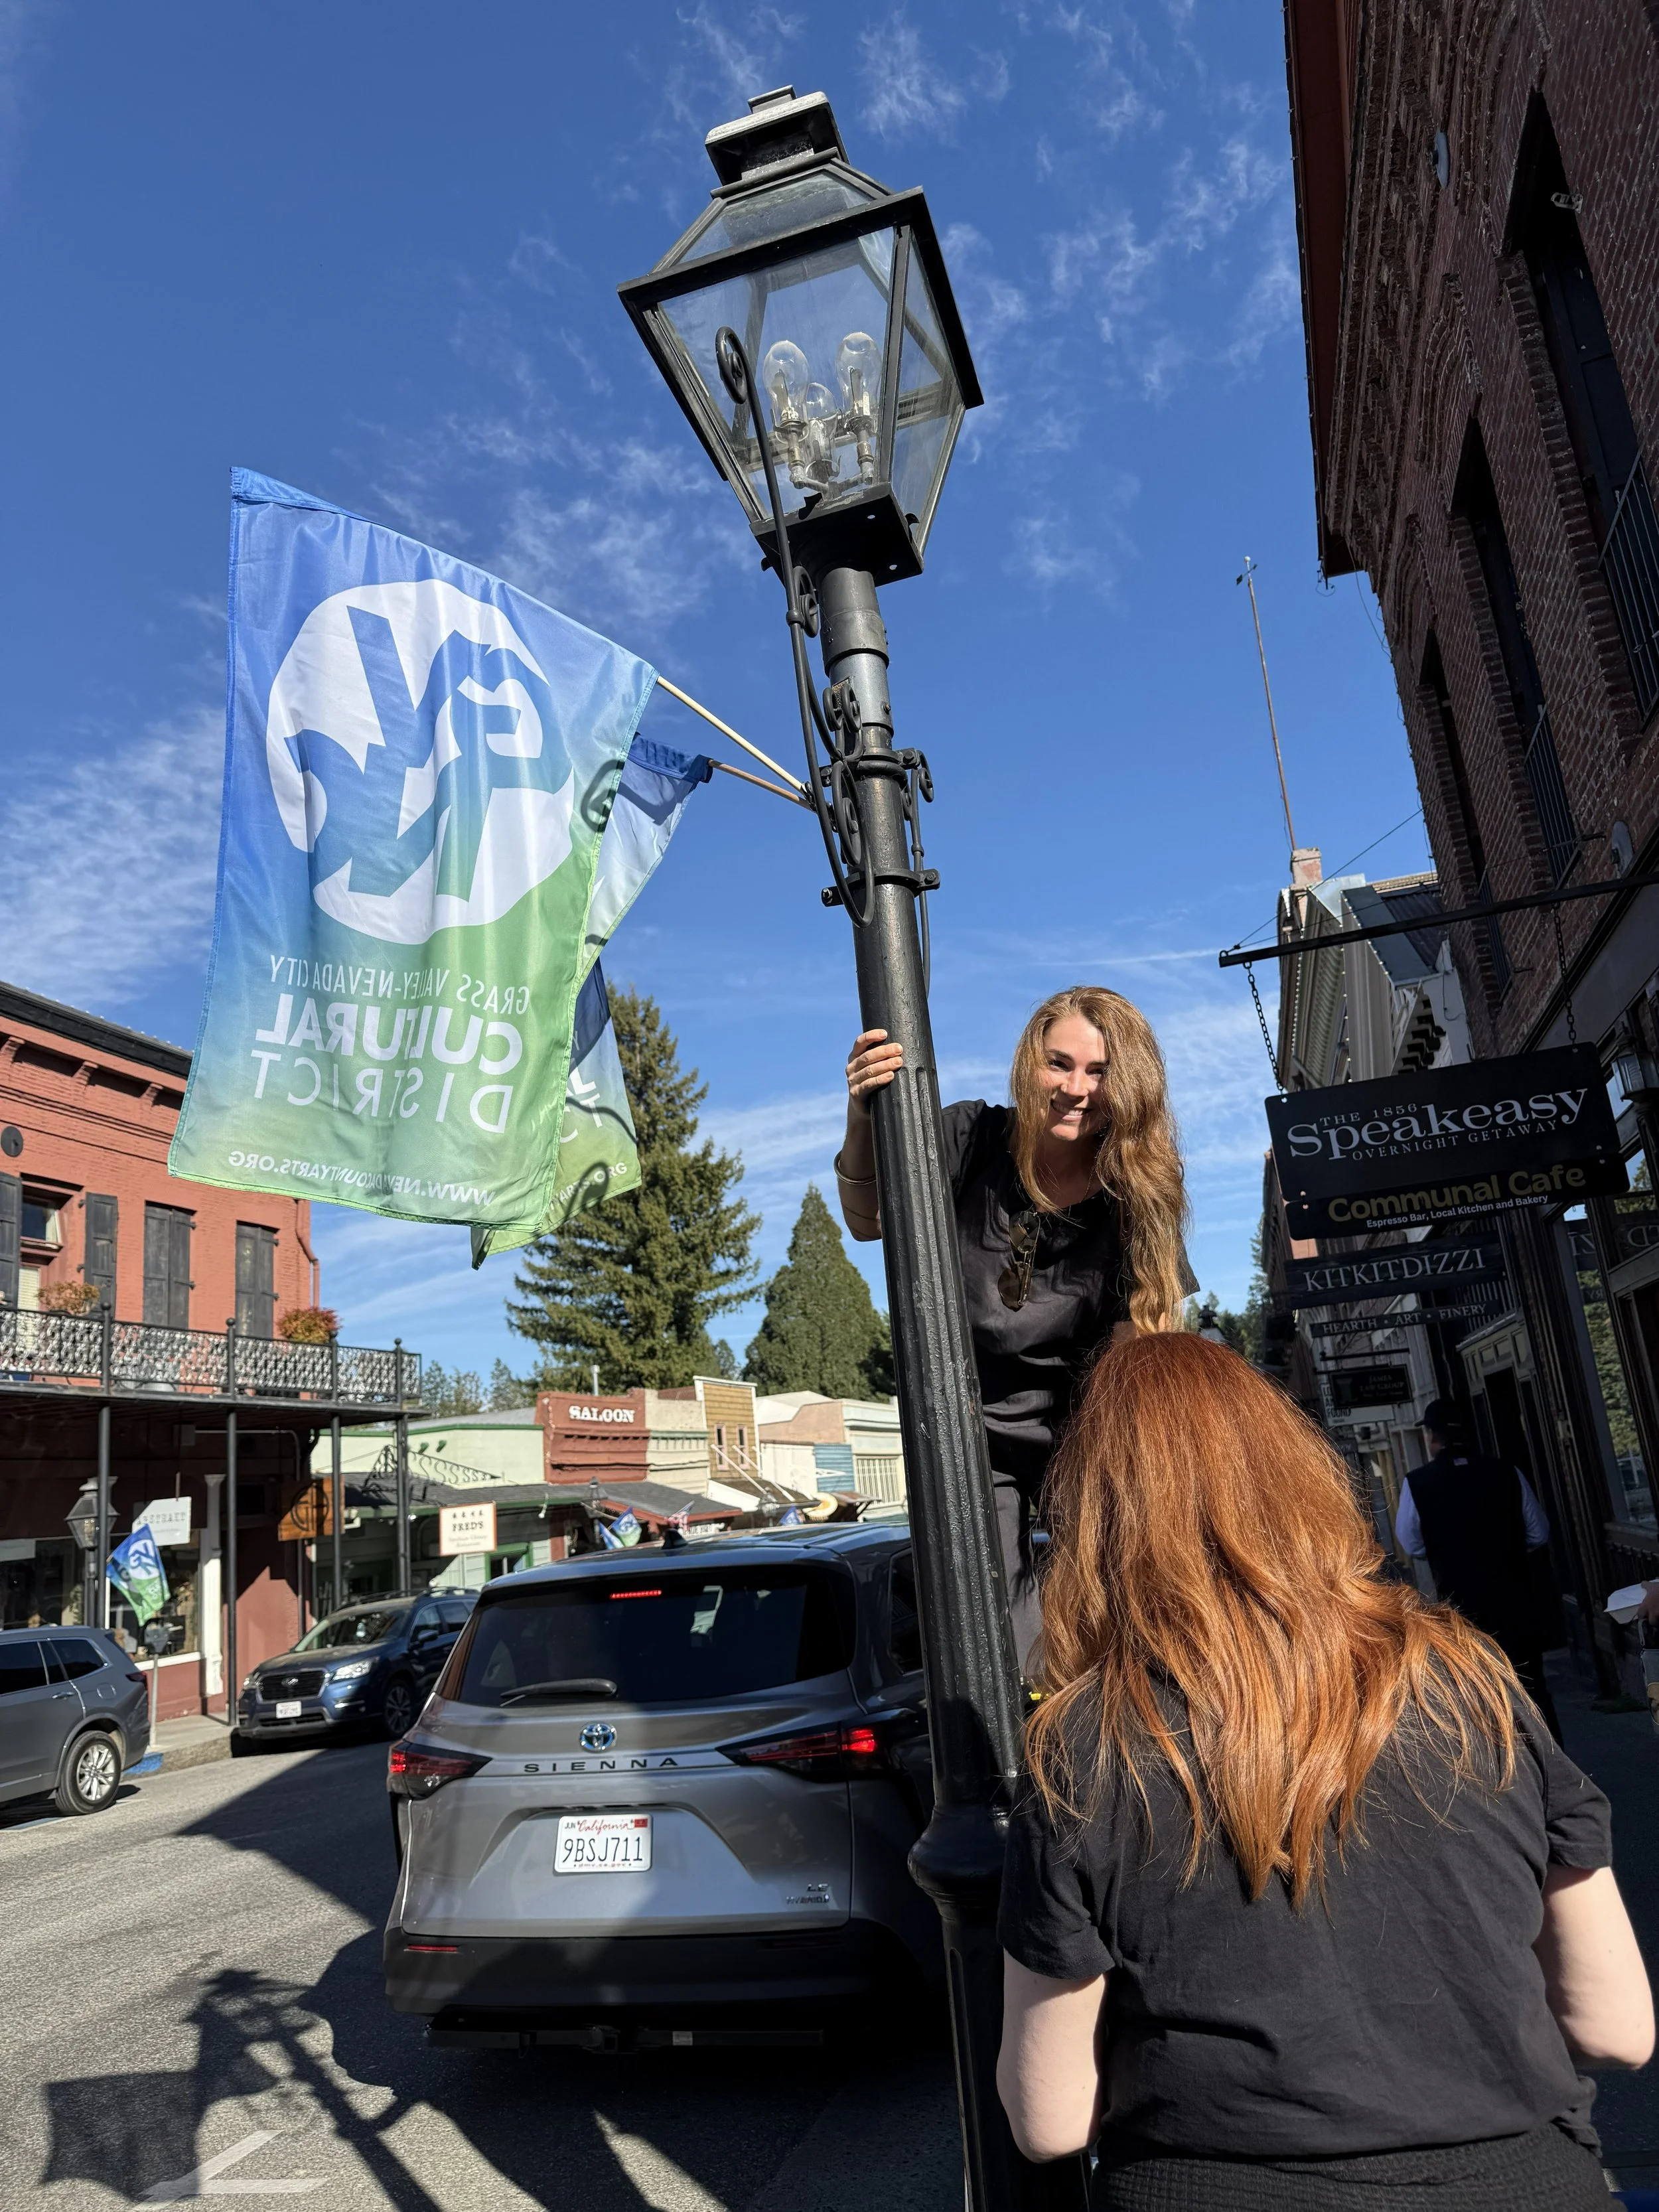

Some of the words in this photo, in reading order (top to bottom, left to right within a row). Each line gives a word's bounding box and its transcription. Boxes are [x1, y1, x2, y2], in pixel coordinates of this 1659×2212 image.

[1287, 1088, 1588, 1160] Speakeasy
[1320, 1112, 1360, 1127] THE
[1373, 1104, 1417, 1119] 1856
[1352, 1135, 1459, 1161] OVERNIGHT
[1468, 1120, 1557, 1143] GETAWAY
[1329, 1175, 1501, 1222] Communal
[1508, 1164, 1587, 1196] Cafe
[1366, 1216, 1408, 1228] Espresso
[1409, 1212, 1429, 1223] Bar,
[1430, 1207, 1457, 1219] Local
[1458, 1202, 1494, 1215] Kitchen
[1496, 1197, 1514, 1209] and
[1516, 1194, 1549, 1207] Bakery
[1303, 1248, 1486, 1291] KITKITDIZZI
[1323, 1318, 1378, 1335] HEARTH
[1395, 1311, 1422, 1326] ART
[1439, 1303, 1487, 1319] FINERY
[569, 1405, 635, 1424] SALOON
[524, 1757, 679, 1773] SIENNA
[578, 1818, 632, 1835] California
[562, 1836, 643, 1863] 9BSJ711
